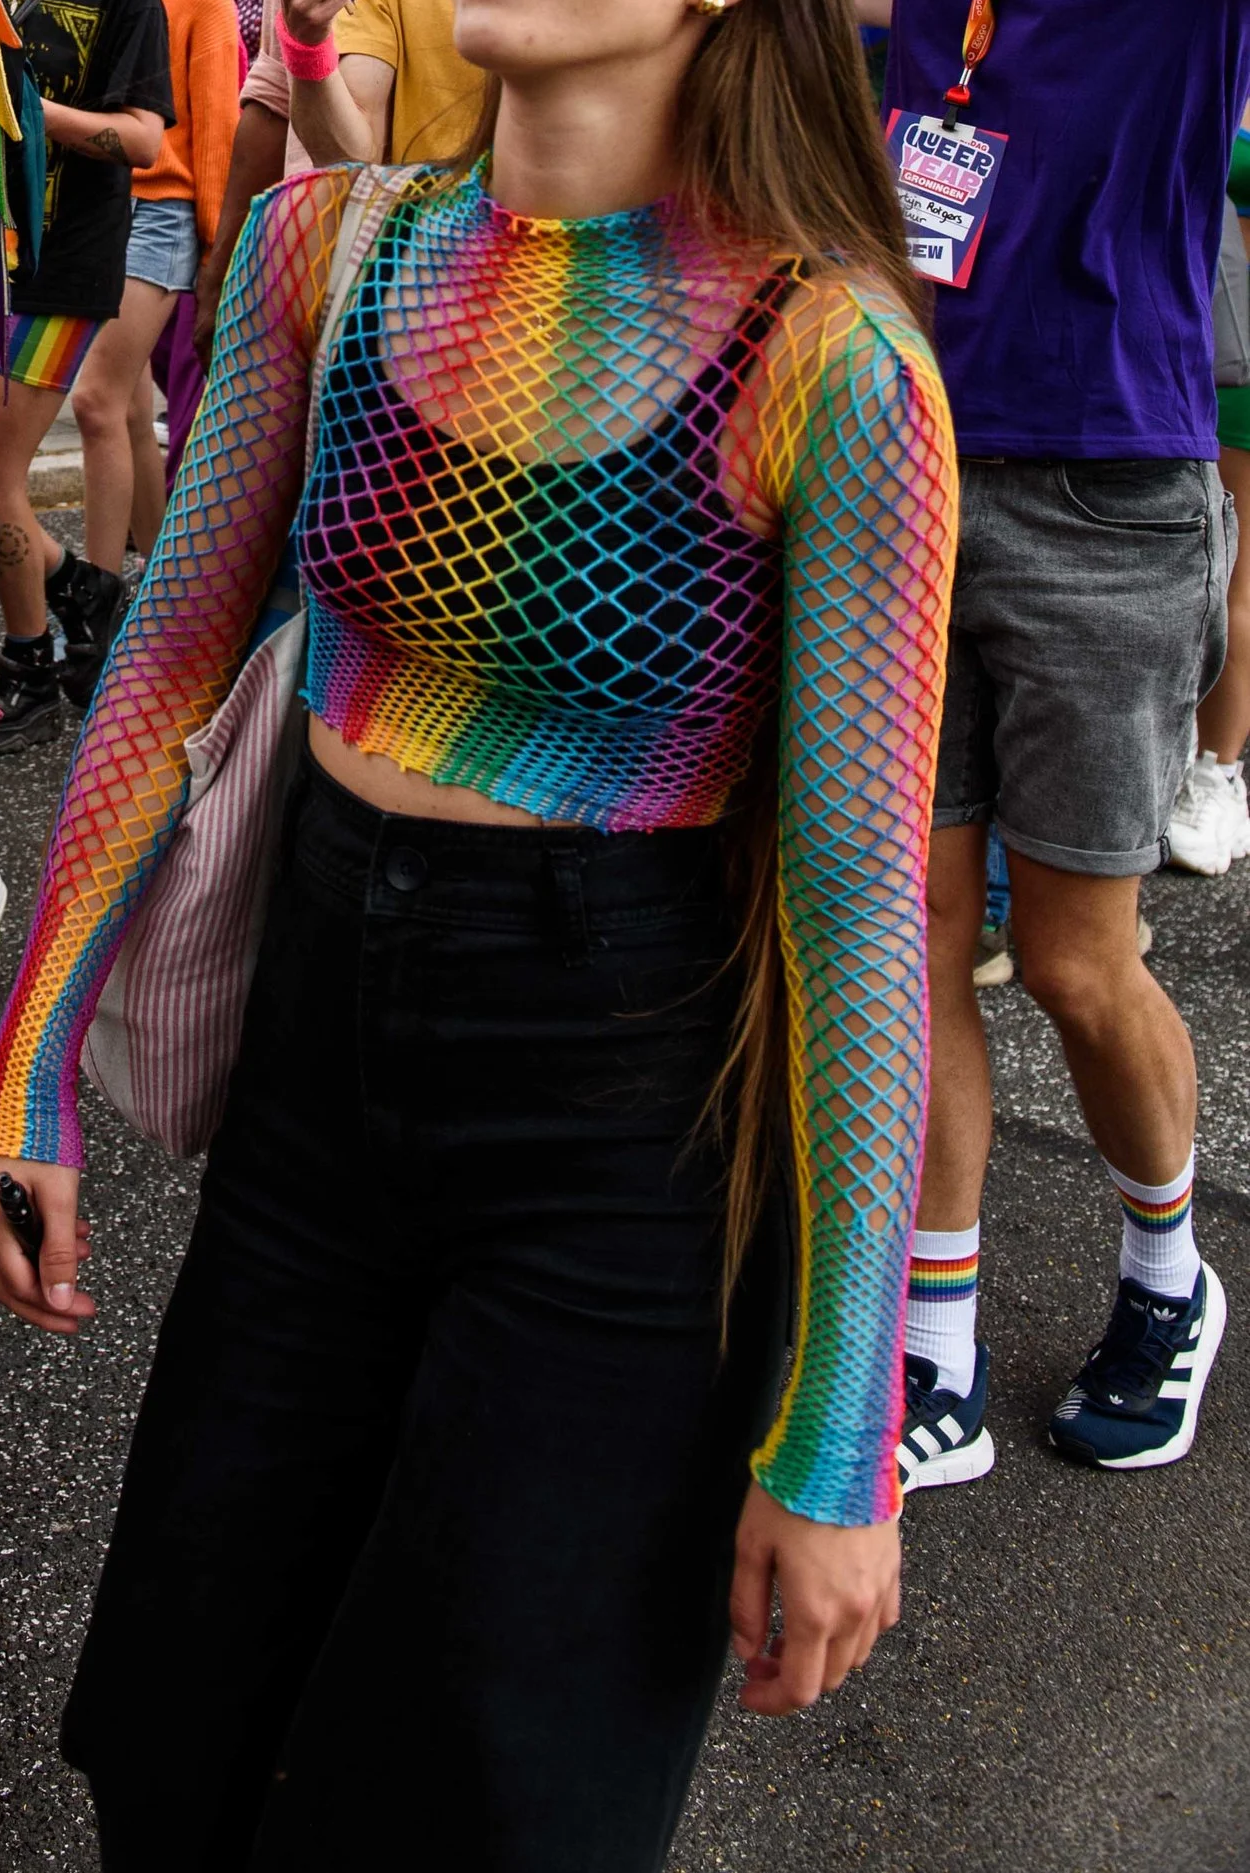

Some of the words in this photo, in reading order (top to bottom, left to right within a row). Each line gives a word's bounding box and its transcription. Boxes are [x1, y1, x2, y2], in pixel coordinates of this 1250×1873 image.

[903, 144, 982, 196] YEAR
[904, 124, 994, 178] QUEER
[904, 172, 965, 200] GRONINGEN
